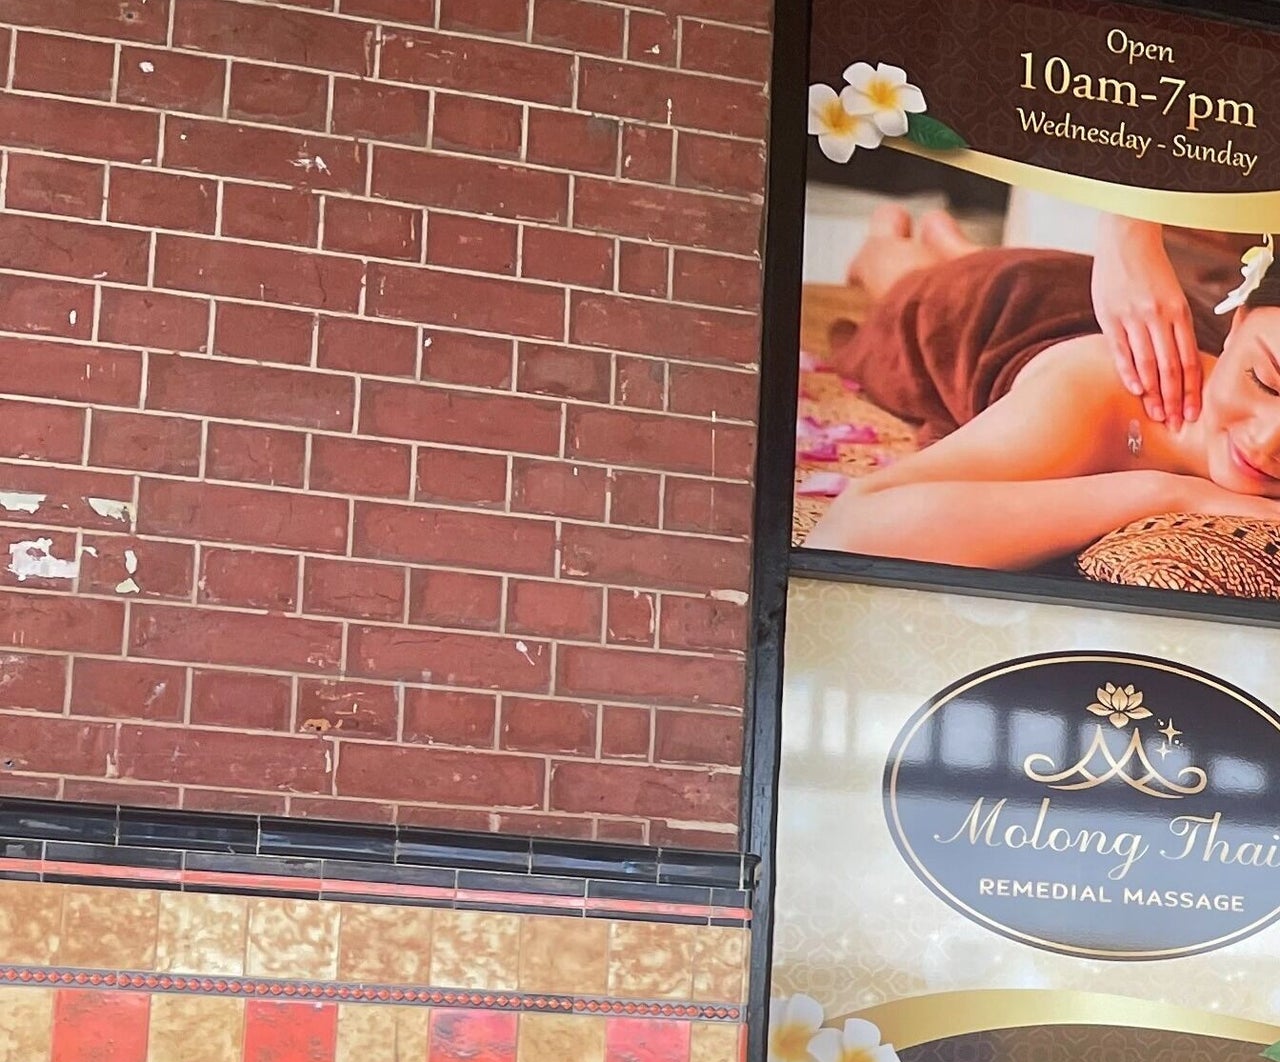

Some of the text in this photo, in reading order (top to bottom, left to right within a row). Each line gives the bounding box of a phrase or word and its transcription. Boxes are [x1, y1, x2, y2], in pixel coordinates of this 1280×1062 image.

[1106, 28, 1175, 64] Open
[1019, 51, 1257, 131] 10am-7pm
[1016, 107, 1152, 159] Wednesday
[1172, 134, 1258, 176] Sunday
[933, 797, 1150, 881] Molong
[979, 878, 1245, 912] REMEDIAL MASSAGE
